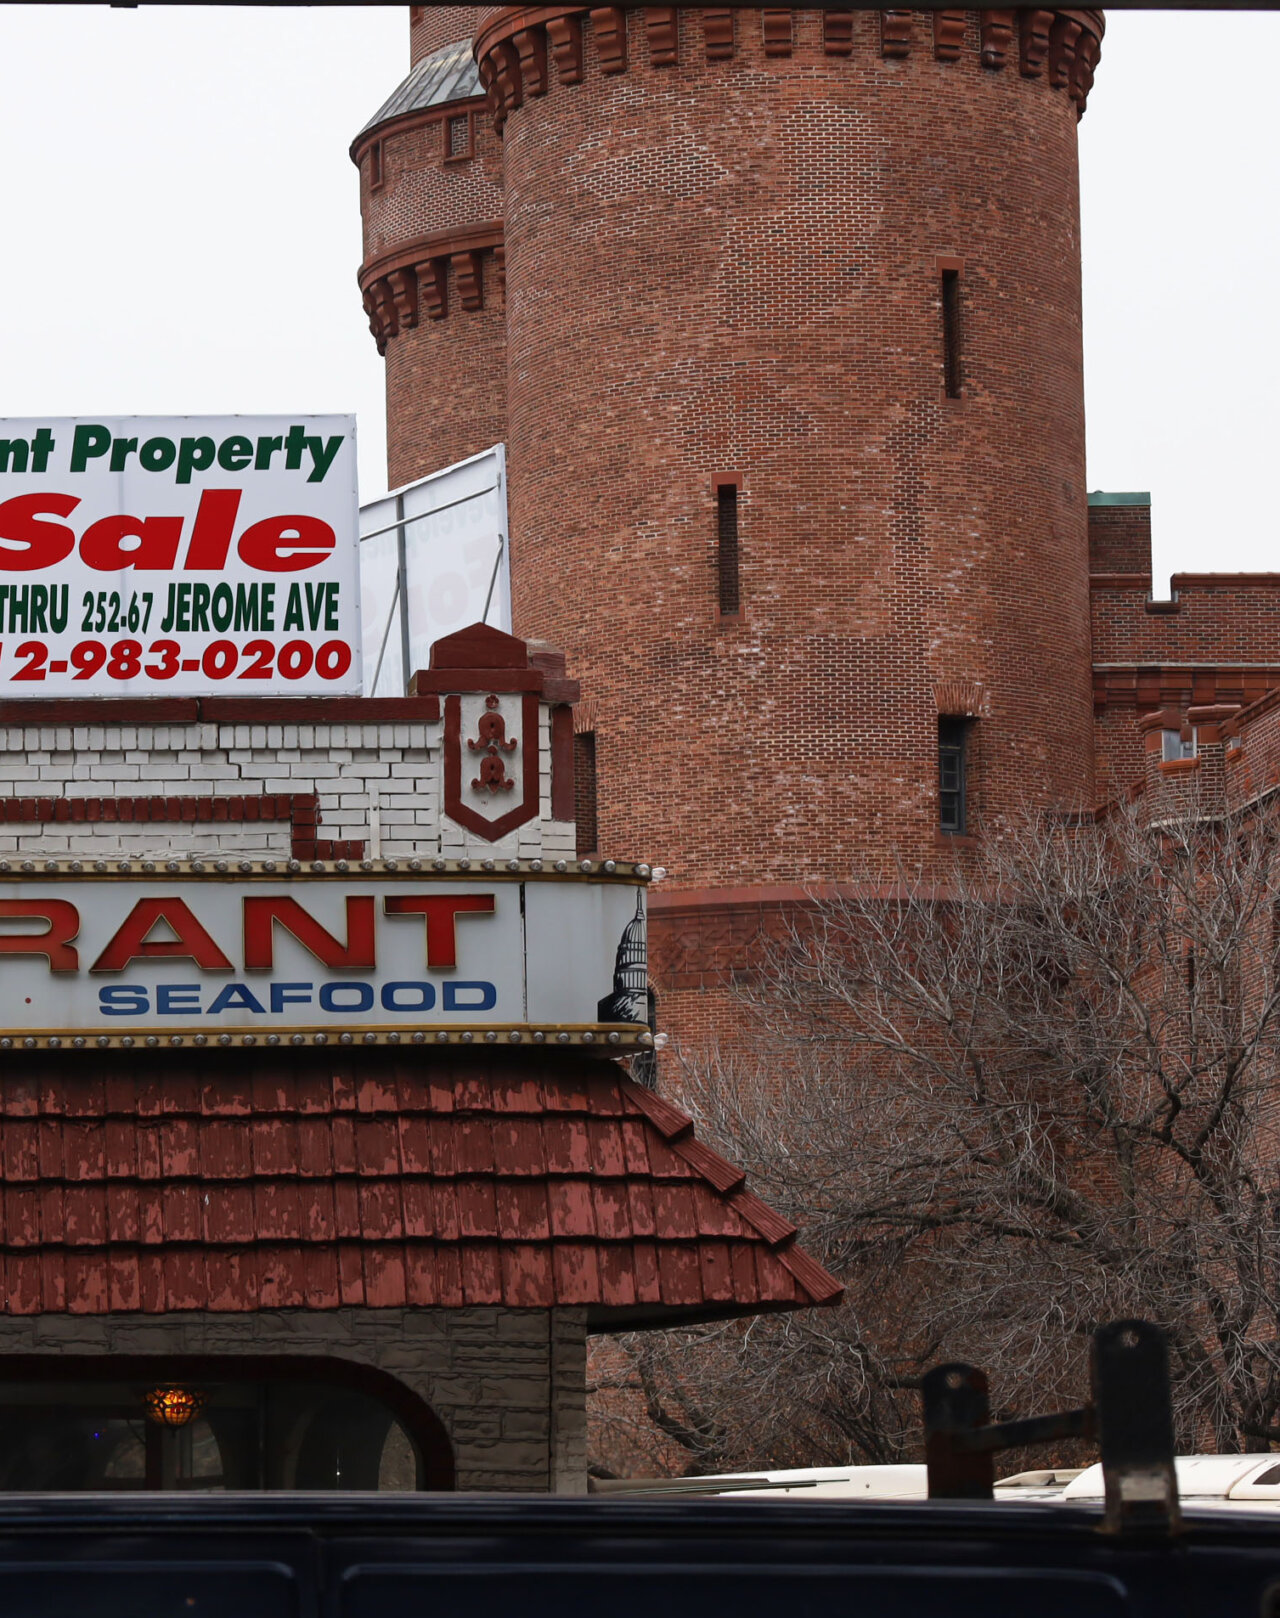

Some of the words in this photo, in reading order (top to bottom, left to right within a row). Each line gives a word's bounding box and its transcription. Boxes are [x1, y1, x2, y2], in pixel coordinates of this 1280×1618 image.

[70, 425, 344, 484] Property
[161, 583, 275, 632] JEROME
[283, 583, 339, 631] AVE
[100, 982, 497, 1015] SEAFOOD
